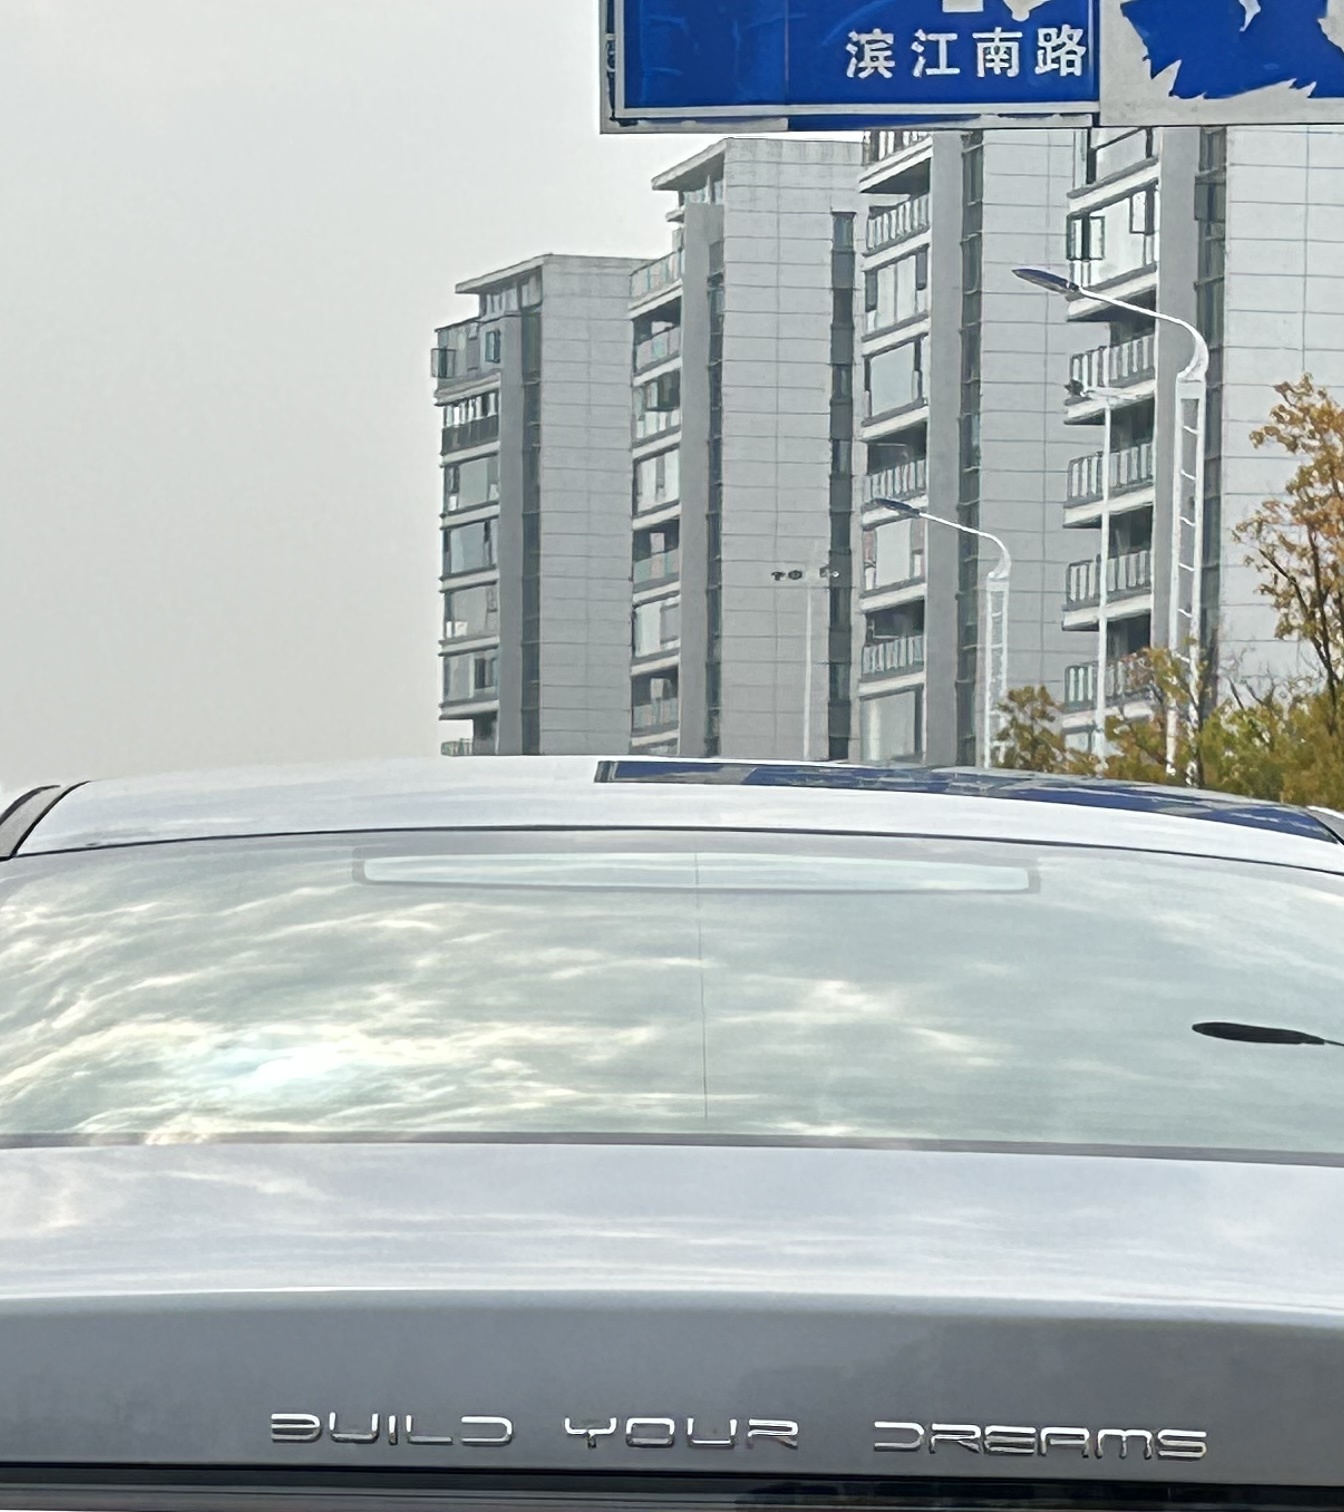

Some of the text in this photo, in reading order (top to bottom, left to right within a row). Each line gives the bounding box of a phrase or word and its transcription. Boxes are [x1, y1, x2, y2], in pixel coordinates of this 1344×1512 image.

[845, 24, 1088, 79] 滨江南路
[270, 1412, 1208, 1460] BUILD YOUR DREAMS
